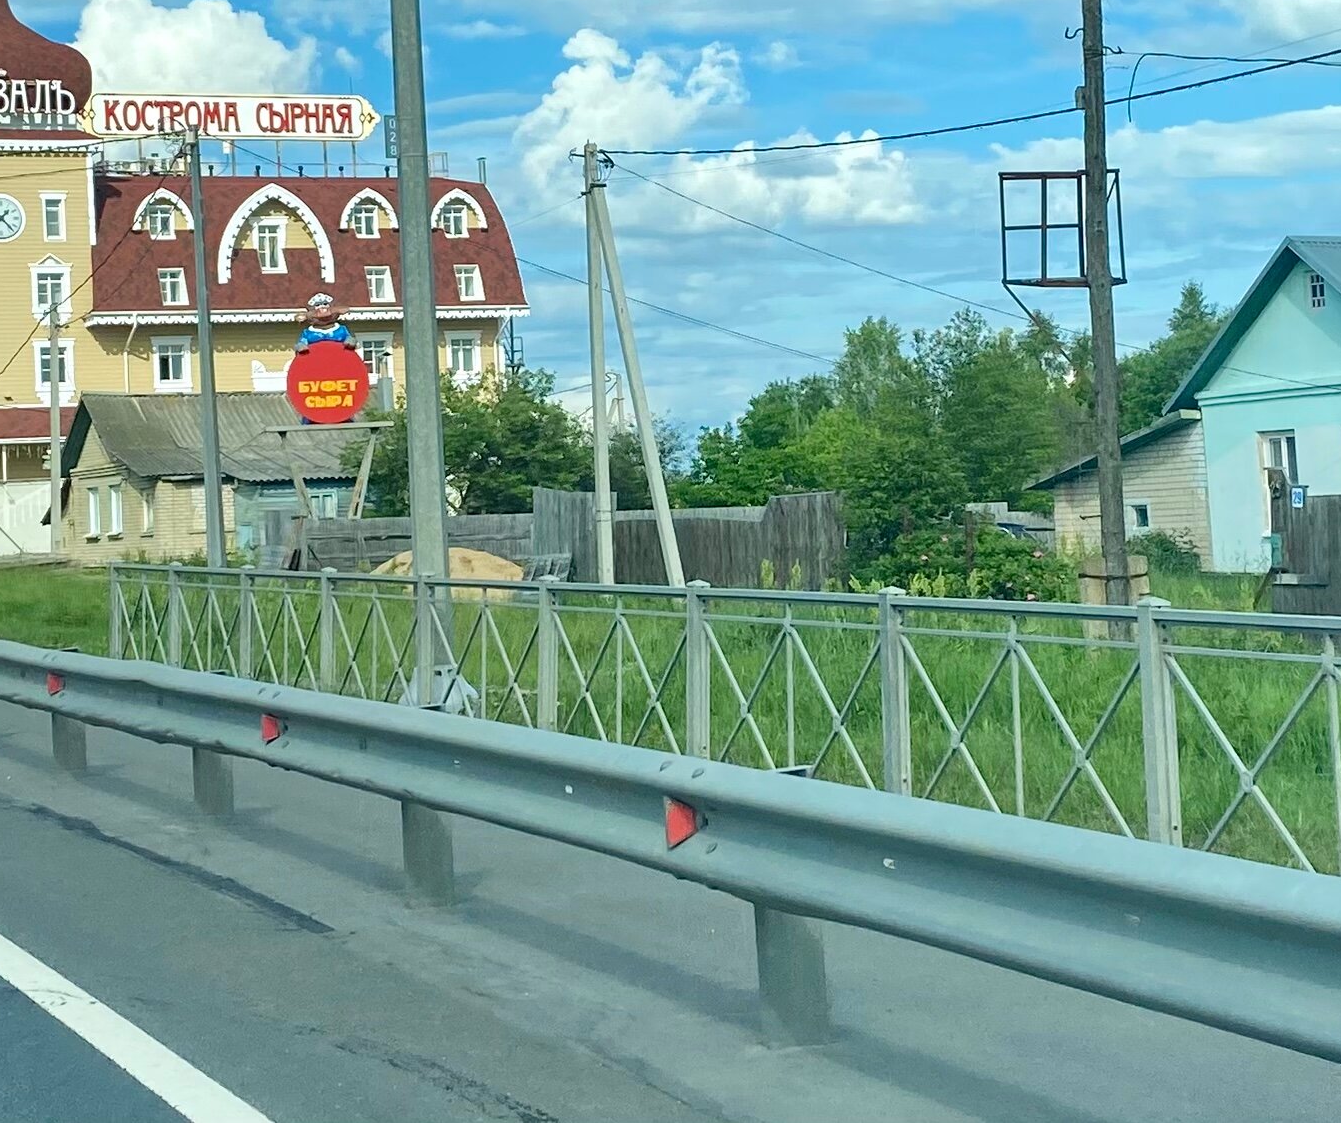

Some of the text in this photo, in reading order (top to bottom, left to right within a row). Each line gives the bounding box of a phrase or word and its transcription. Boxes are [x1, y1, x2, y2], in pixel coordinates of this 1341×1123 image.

[103, 100, 354, 134] КОСТРОМА СЫРНАЯ
[389, 118, 397, 156] 028
[298, 380, 358, 393] БУФЕТ
[305, 395, 354, 408] СЫРА
